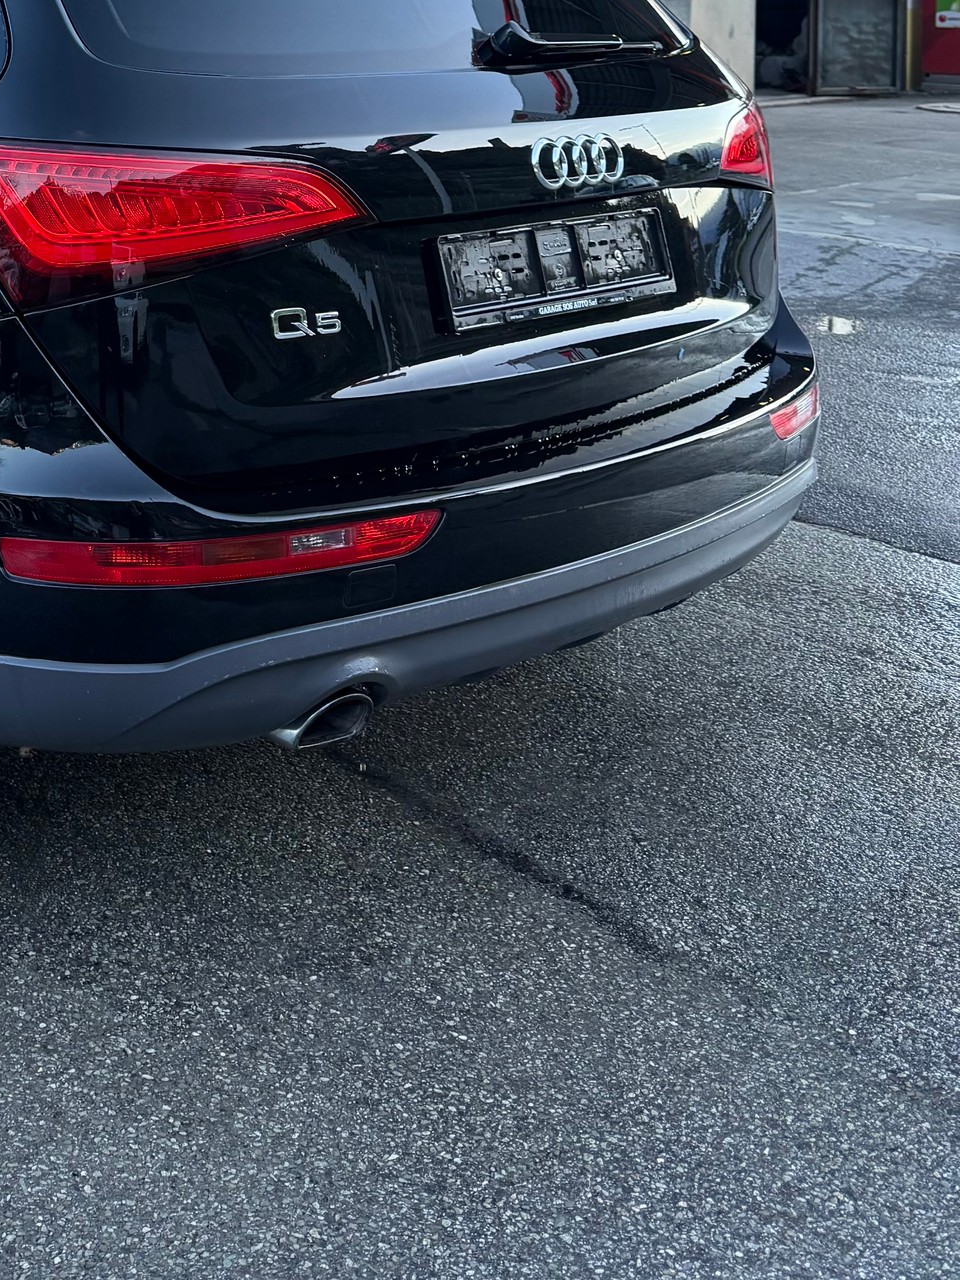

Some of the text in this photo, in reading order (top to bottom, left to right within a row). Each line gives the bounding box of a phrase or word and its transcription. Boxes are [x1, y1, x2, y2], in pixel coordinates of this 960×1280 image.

[539, 304, 562, 315] GARAGE
[574, 300, 589, 309] AUTO
[270, 307, 342, 340] Q5
